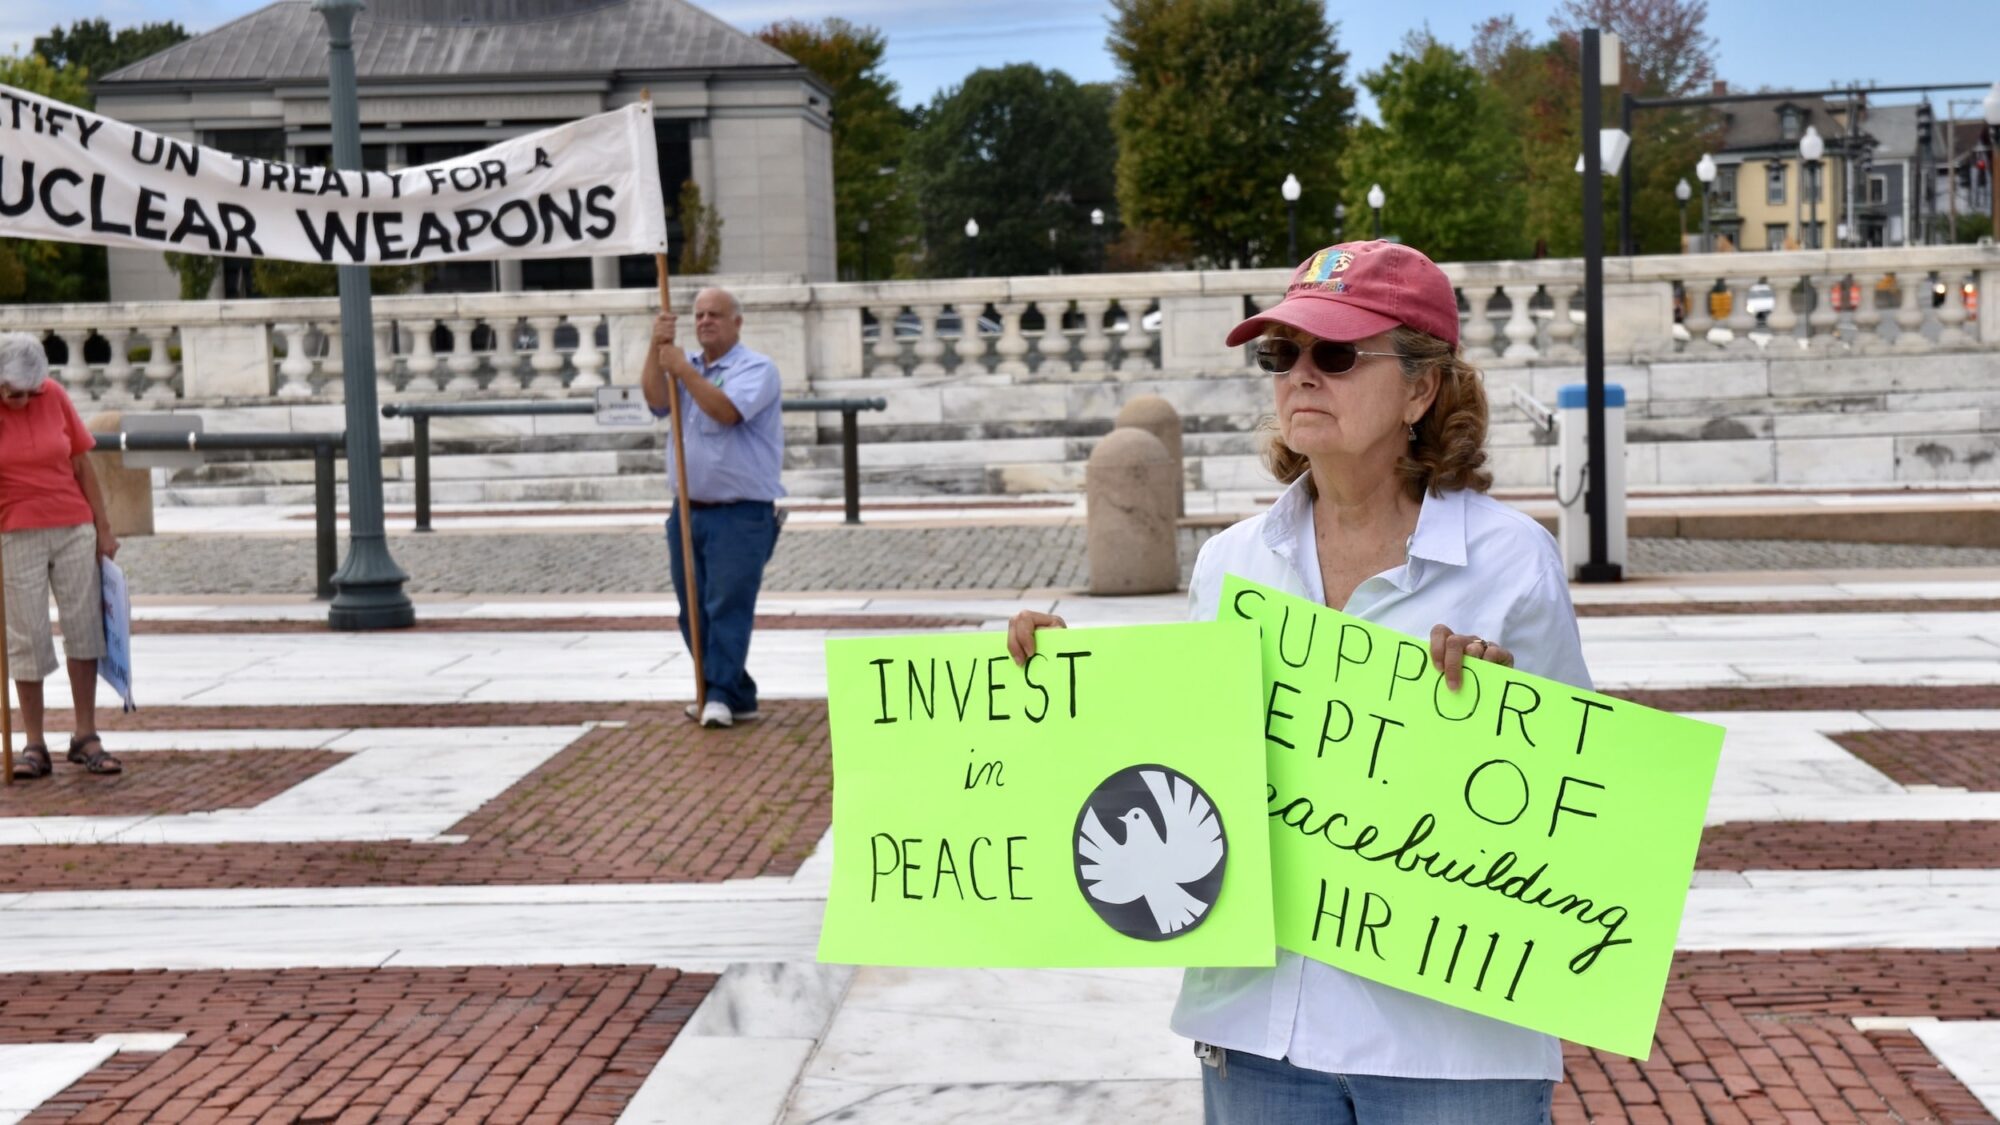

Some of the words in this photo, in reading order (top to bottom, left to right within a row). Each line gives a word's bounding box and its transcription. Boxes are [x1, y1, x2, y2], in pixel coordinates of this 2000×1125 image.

[0, 92, 103, 150] TIFY
[131, 130, 199, 177] UN
[231, 154, 402, 199] TREATY
[426, 160, 507, 195] FOR
[526, 147, 552, 174] A
[0, 154, 264, 256] UCLEAR
[296, 185, 616, 262] WEAPONS
[869, 650, 1092, 724] INVEST
[1234, 589, 1613, 755] SUPPORT
[963, 748, 1006, 790] in
[1265, 681, 1405, 785] EPT.
[1464, 759, 1606, 838] OF
[870, 833, 1034, 903] PEACE
[1266, 783, 1633, 975] eacebuilding
[1312, 878, 1386, 961] HR
